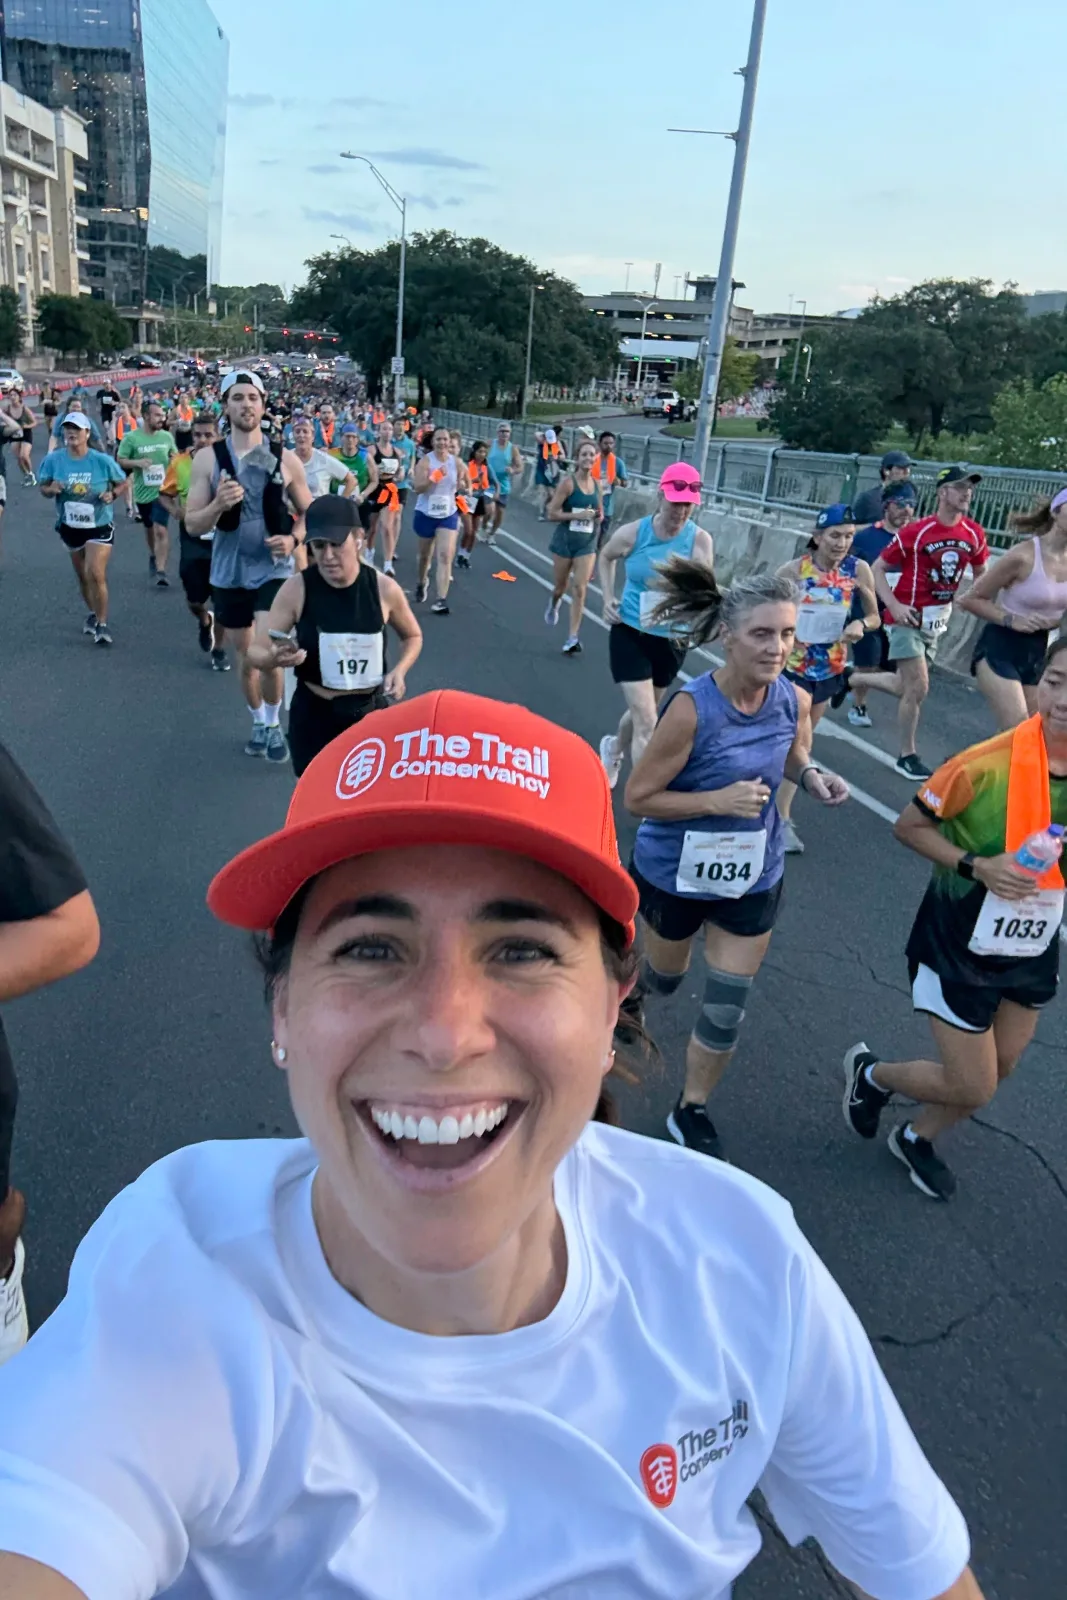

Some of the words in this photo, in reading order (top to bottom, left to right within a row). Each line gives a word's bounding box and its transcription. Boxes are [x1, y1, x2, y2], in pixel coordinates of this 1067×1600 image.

[336, 658, 369, 675] 197
[394, 727, 470, 761] The
[472, 731, 550, 779] Trail
[389, 758, 551, 800] Conservancy
[694, 861, 752, 882] 1034
[992, 915, 1048, 940] 1033
[677, 1429, 718, 1462] The
[718, 1399, 749, 1442] Til
[679, 1423, 749, 1483] Conservcy
